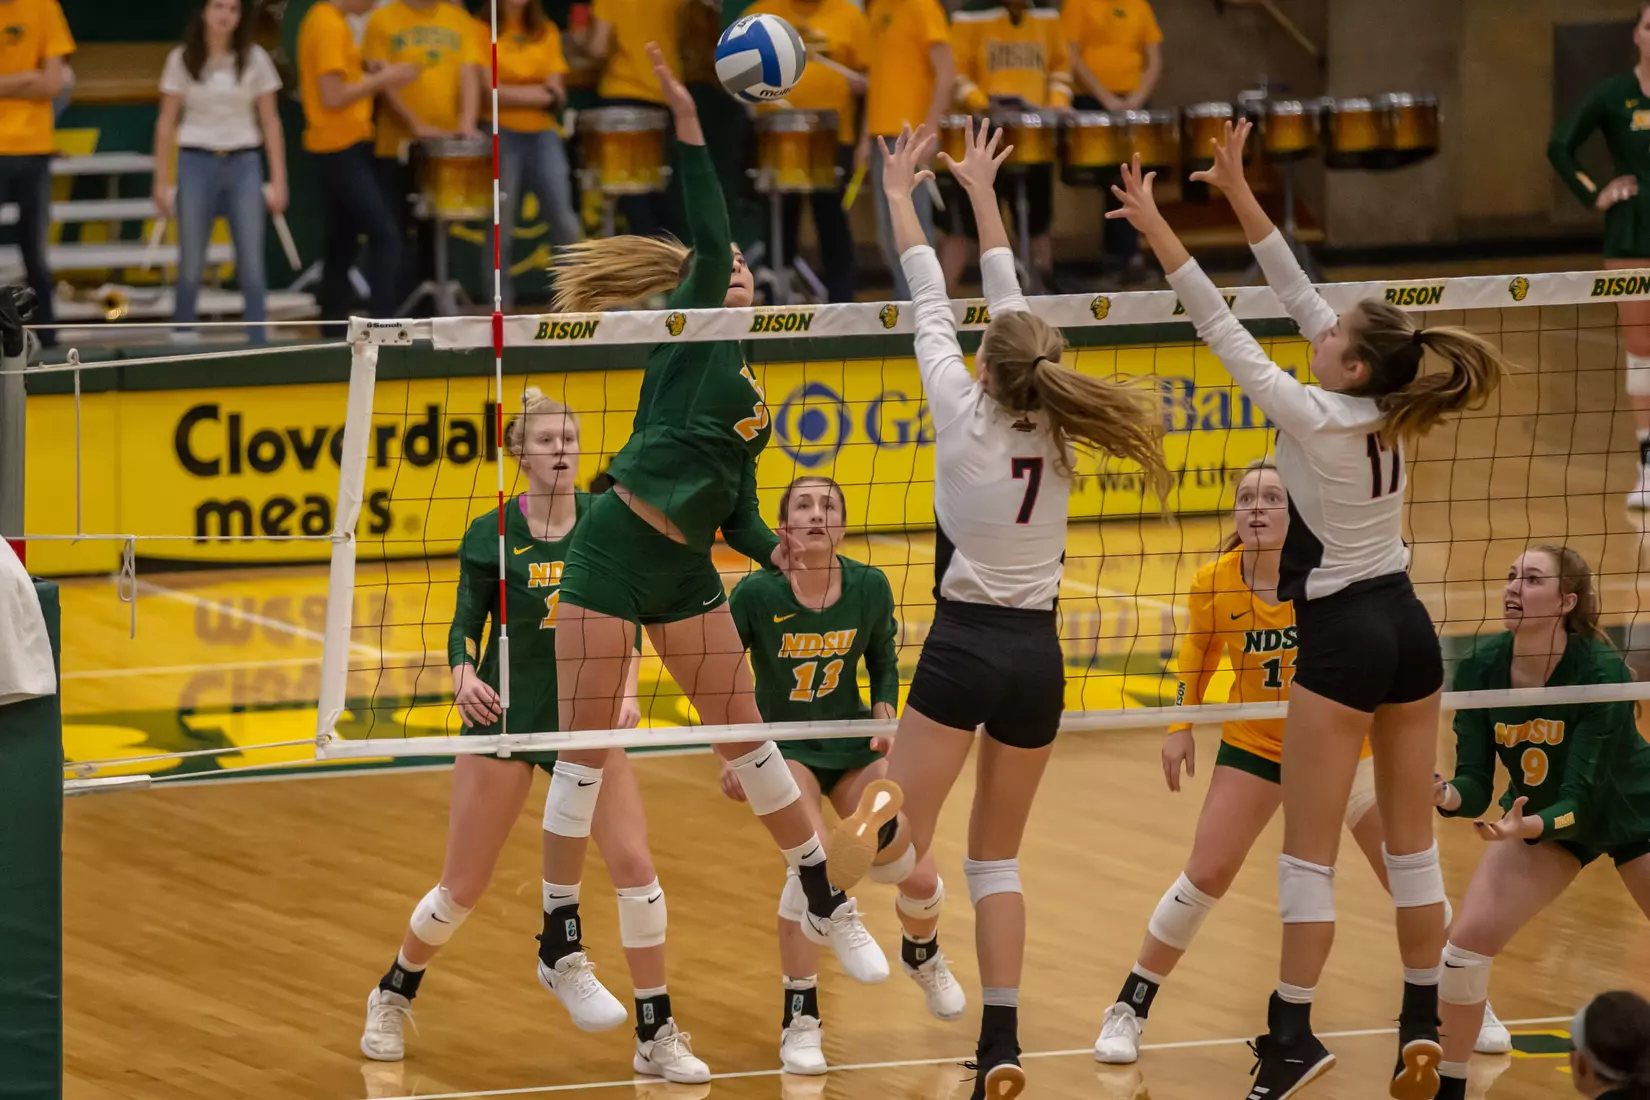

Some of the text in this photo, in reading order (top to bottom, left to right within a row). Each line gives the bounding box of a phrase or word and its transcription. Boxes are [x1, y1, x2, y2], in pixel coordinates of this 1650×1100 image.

[1384, 286, 1445, 306] BISON
[1591, 276, 1650, 296] BISON
[534, 320, 600, 340] BISON
[749, 312, 815, 333] BISON
[173, 401, 518, 477] Clovrdal
[1011, 457, 1044, 524] 7
[195, 490, 393, 544] meas
[528, 561, 565, 588] ND
[778, 628, 857, 658] NDSU
[1243, 625, 1299, 654] NDS
[789, 659, 844, 702] 13
[1260, 656, 1297, 690] 1
[1521, 747, 1549, 787] 9
